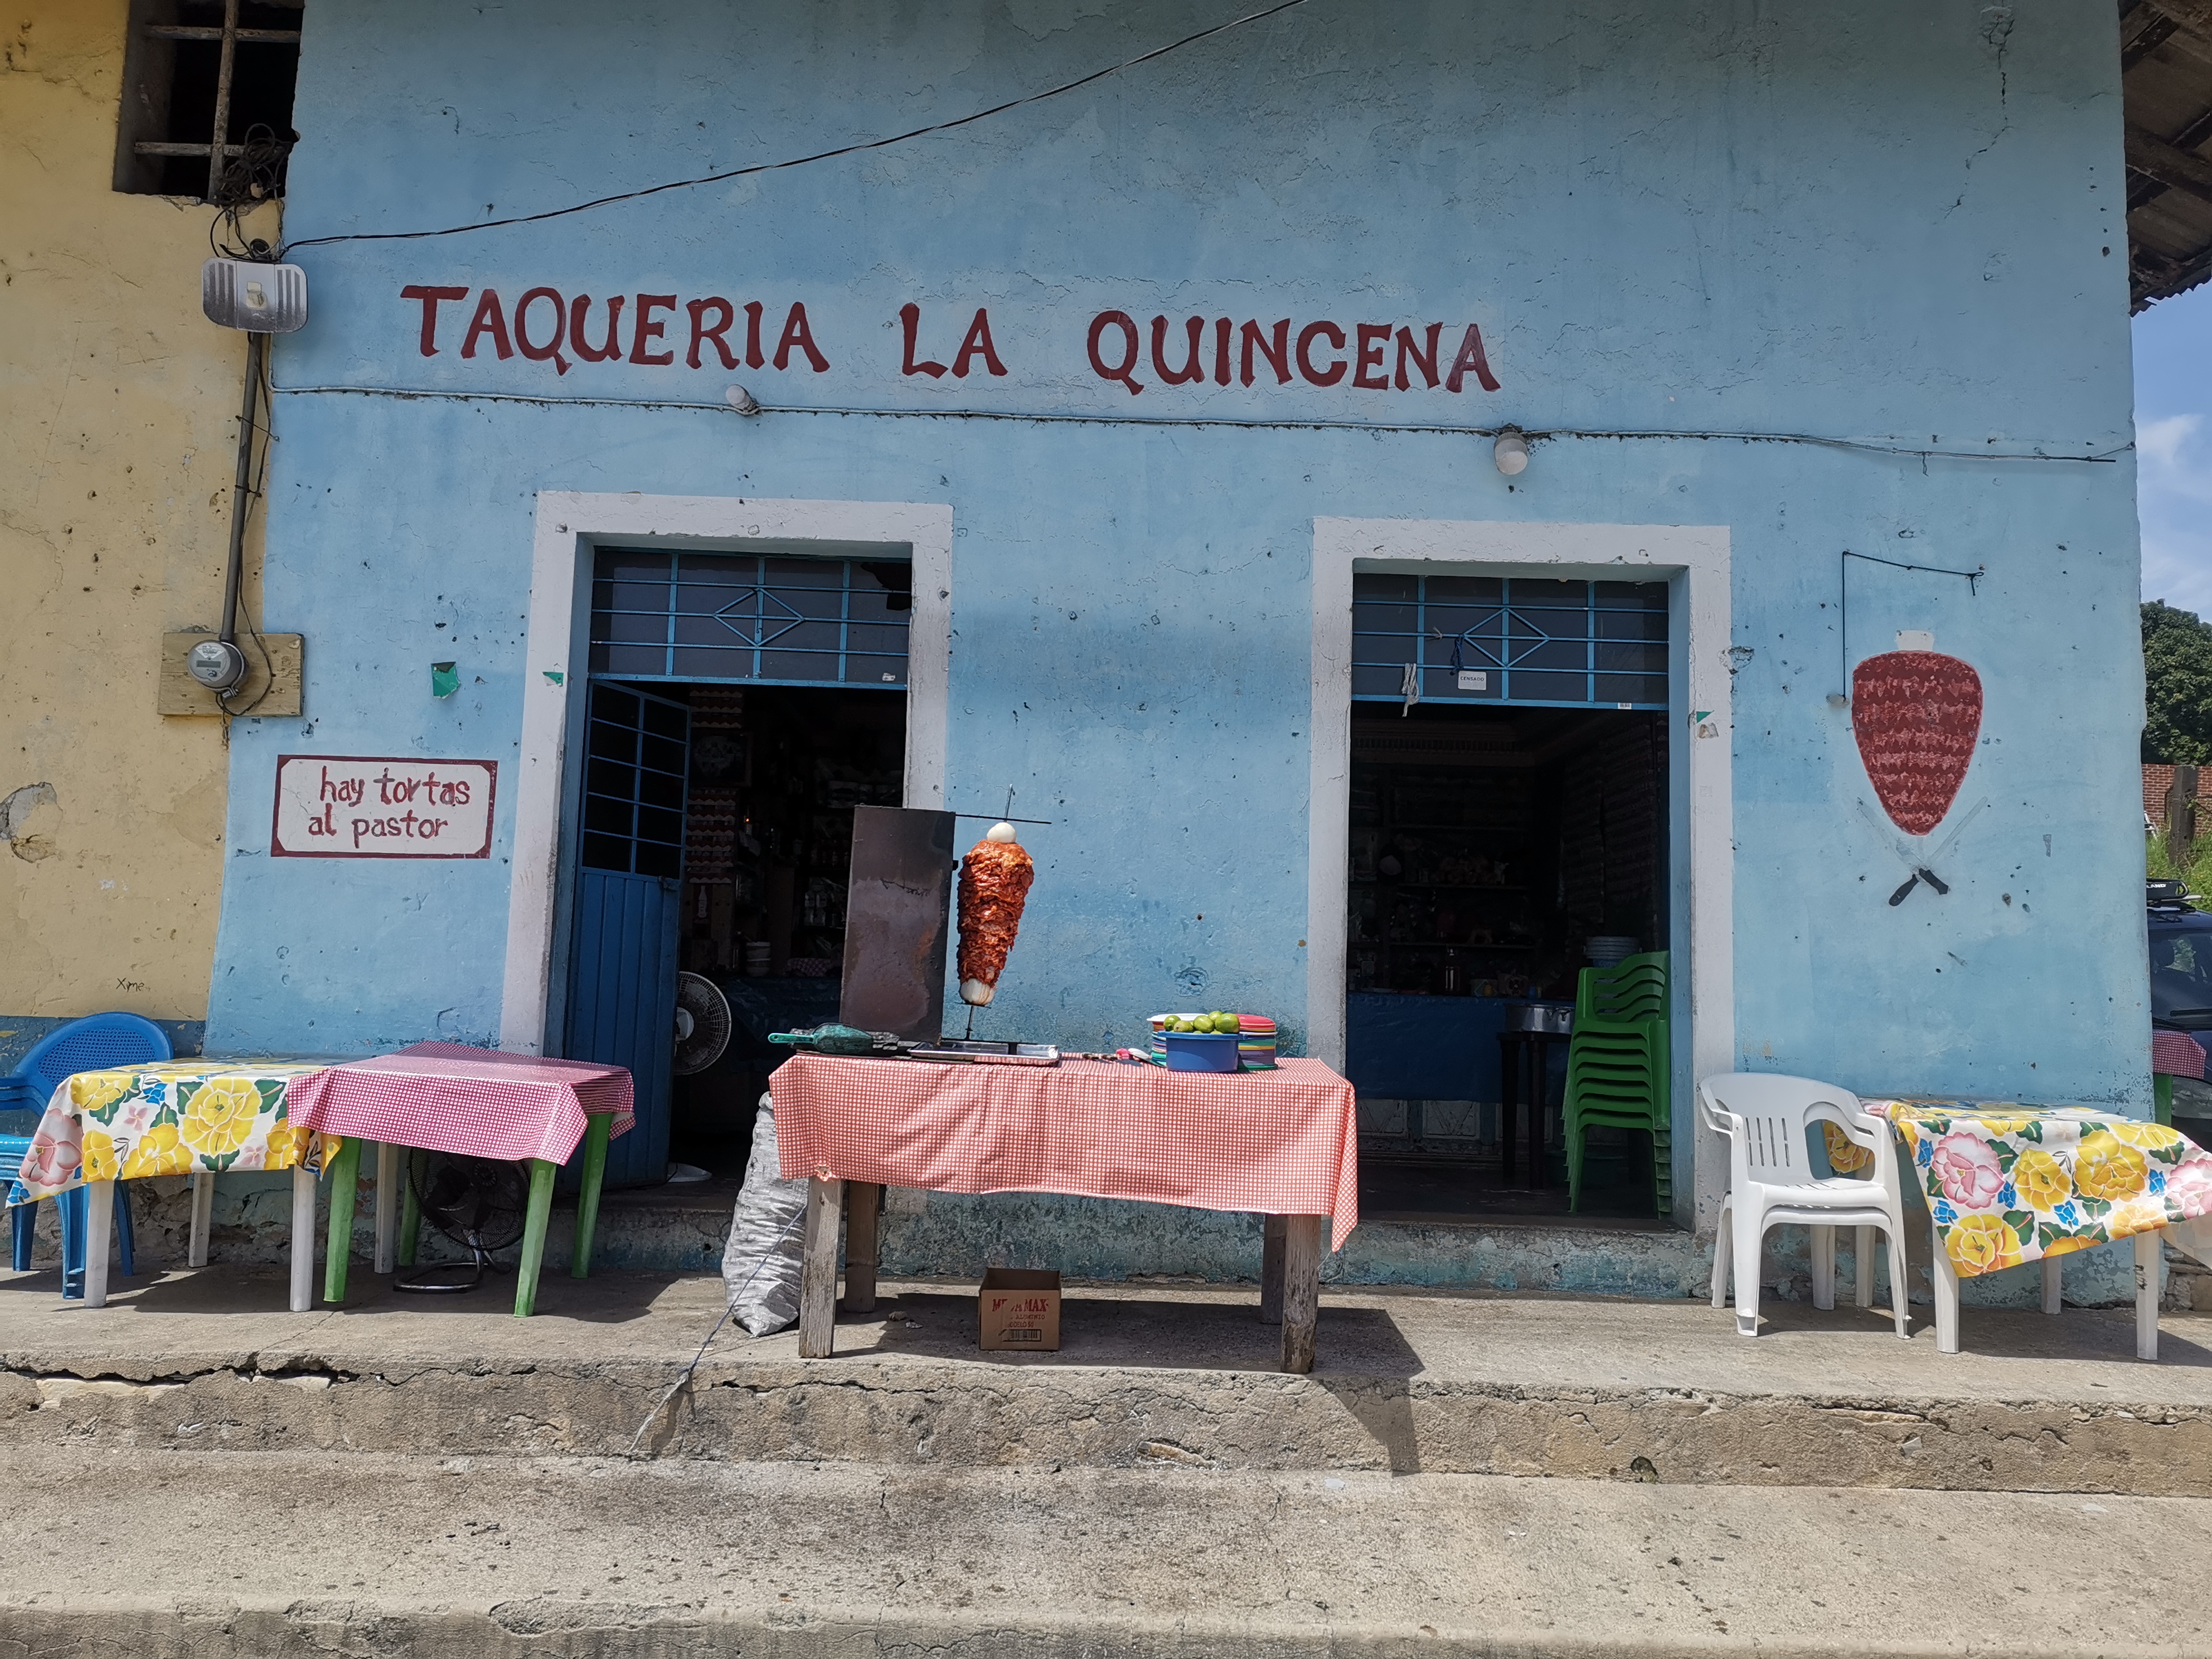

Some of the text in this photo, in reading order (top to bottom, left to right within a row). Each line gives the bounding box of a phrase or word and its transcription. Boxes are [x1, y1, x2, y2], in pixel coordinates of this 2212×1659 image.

[400, 285, 1502, 396] TAQUERIA LA QUINCENA
[320, 765, 471, 808] hay tortas
[308, 803, 449, 849] al pastor
